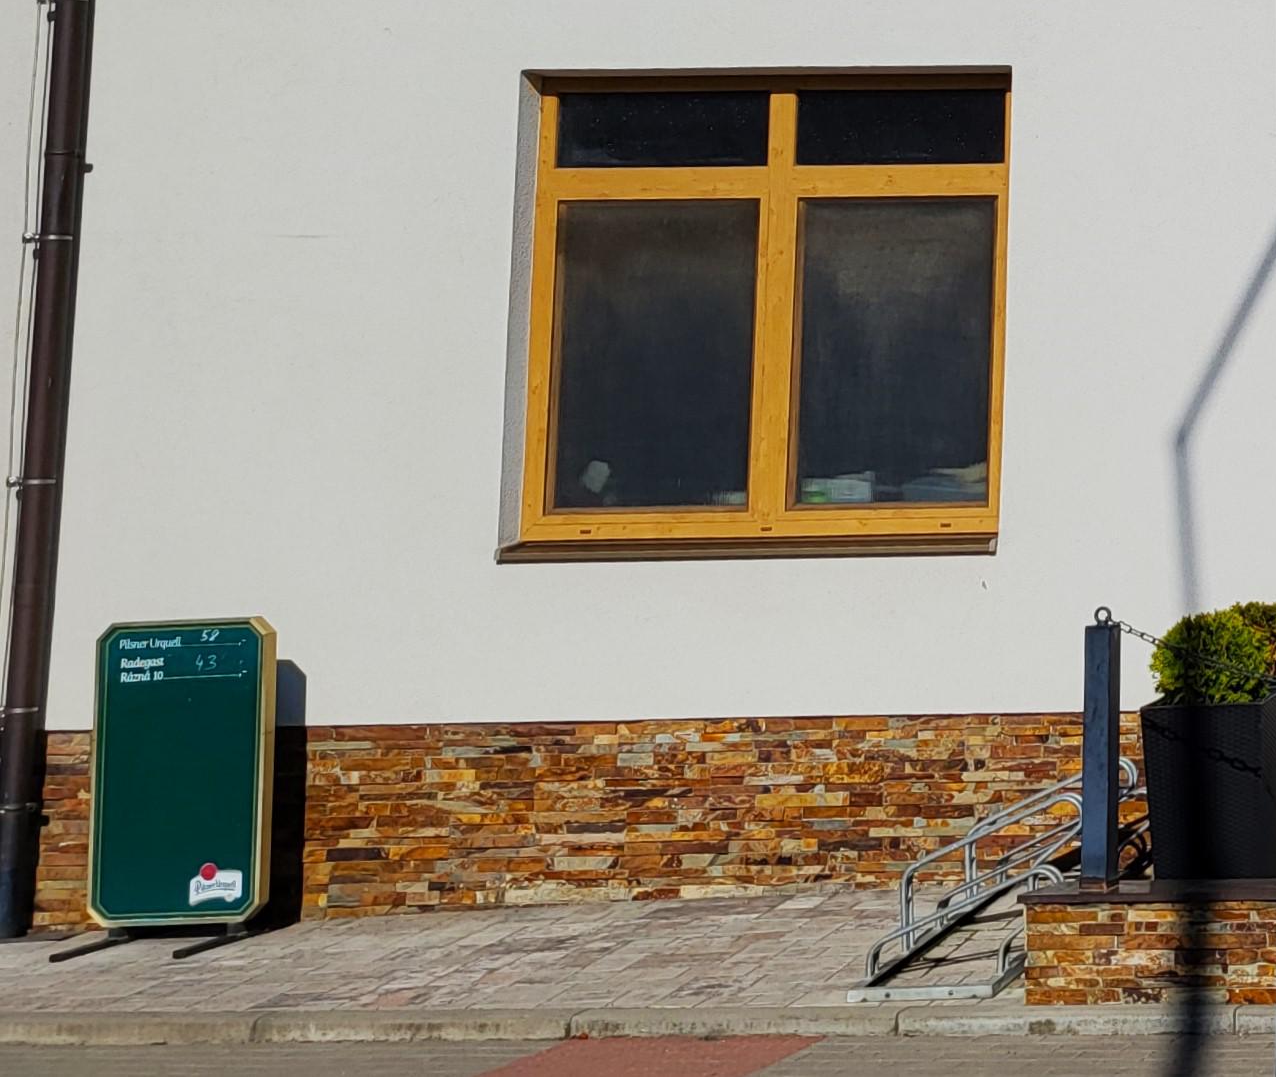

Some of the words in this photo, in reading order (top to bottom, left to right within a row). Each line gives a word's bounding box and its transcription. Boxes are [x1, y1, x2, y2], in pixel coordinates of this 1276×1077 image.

[119, 638, 149, 650] Pilsner
[149, 636, 182, 650] Urquell
[200, 629, 220, 642] 58
[120, 656, 164, 669] Radegast
[195, 654, 217, 671] 43
[120, 670, 151, 683] Rázná
[153, 671, 164, 681] 10
